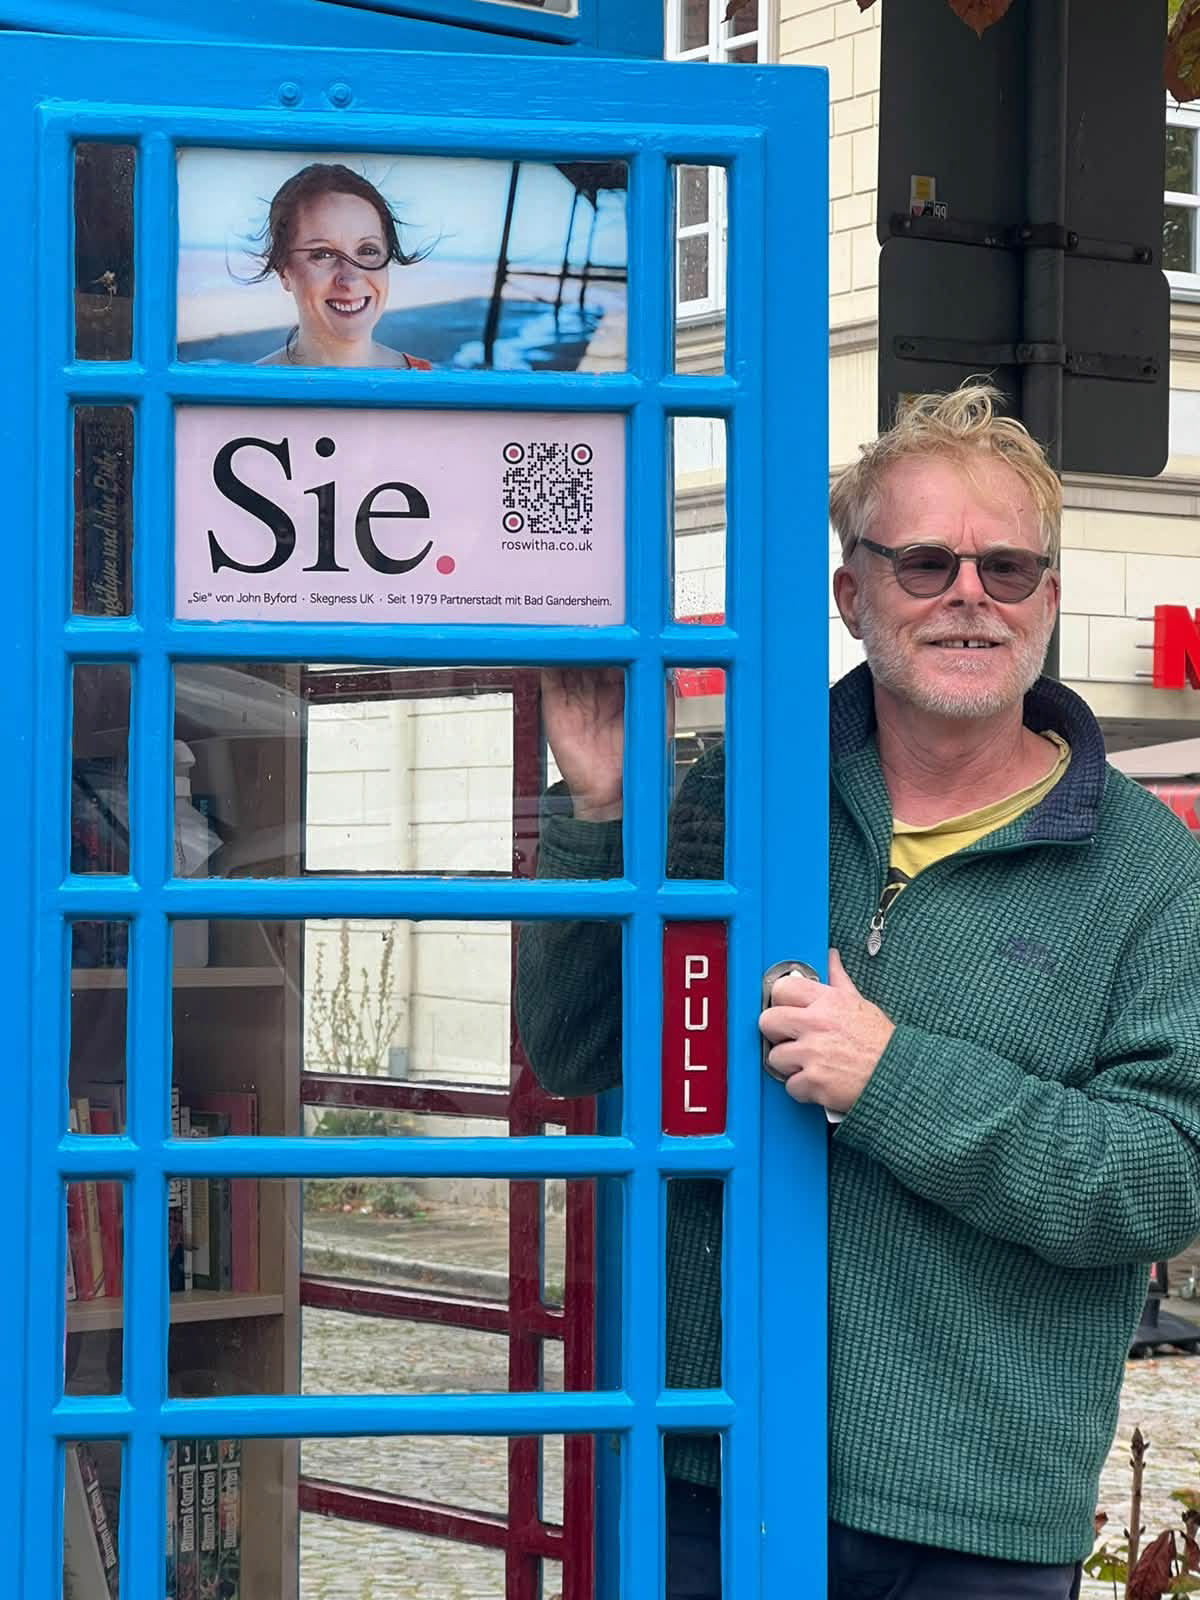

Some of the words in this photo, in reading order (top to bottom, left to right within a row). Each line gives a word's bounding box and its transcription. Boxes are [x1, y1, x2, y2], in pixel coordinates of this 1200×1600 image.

[207, 436, 456, 576] Sie.
[501, 538, 593, 552] roswitha.co.uk
[215, 594, 234, 604] von
[236, 592, 261, 604] John
[263, 592, 297, 606] Byford
[309, 592, 358, 606] Skegness
[359, 593, 375, 605] UK
[387, 593, 407, 605] Seit
[410, 593, 438, 605] 1979
[440, 594, 502, 606] Partnerstadt
[504, 595, 522, 606] mit
[524, 595, 544, 606] Bad
[545, 595, 613, 607] Gandersheim.
[684, 955, 709, 1113] PULL
